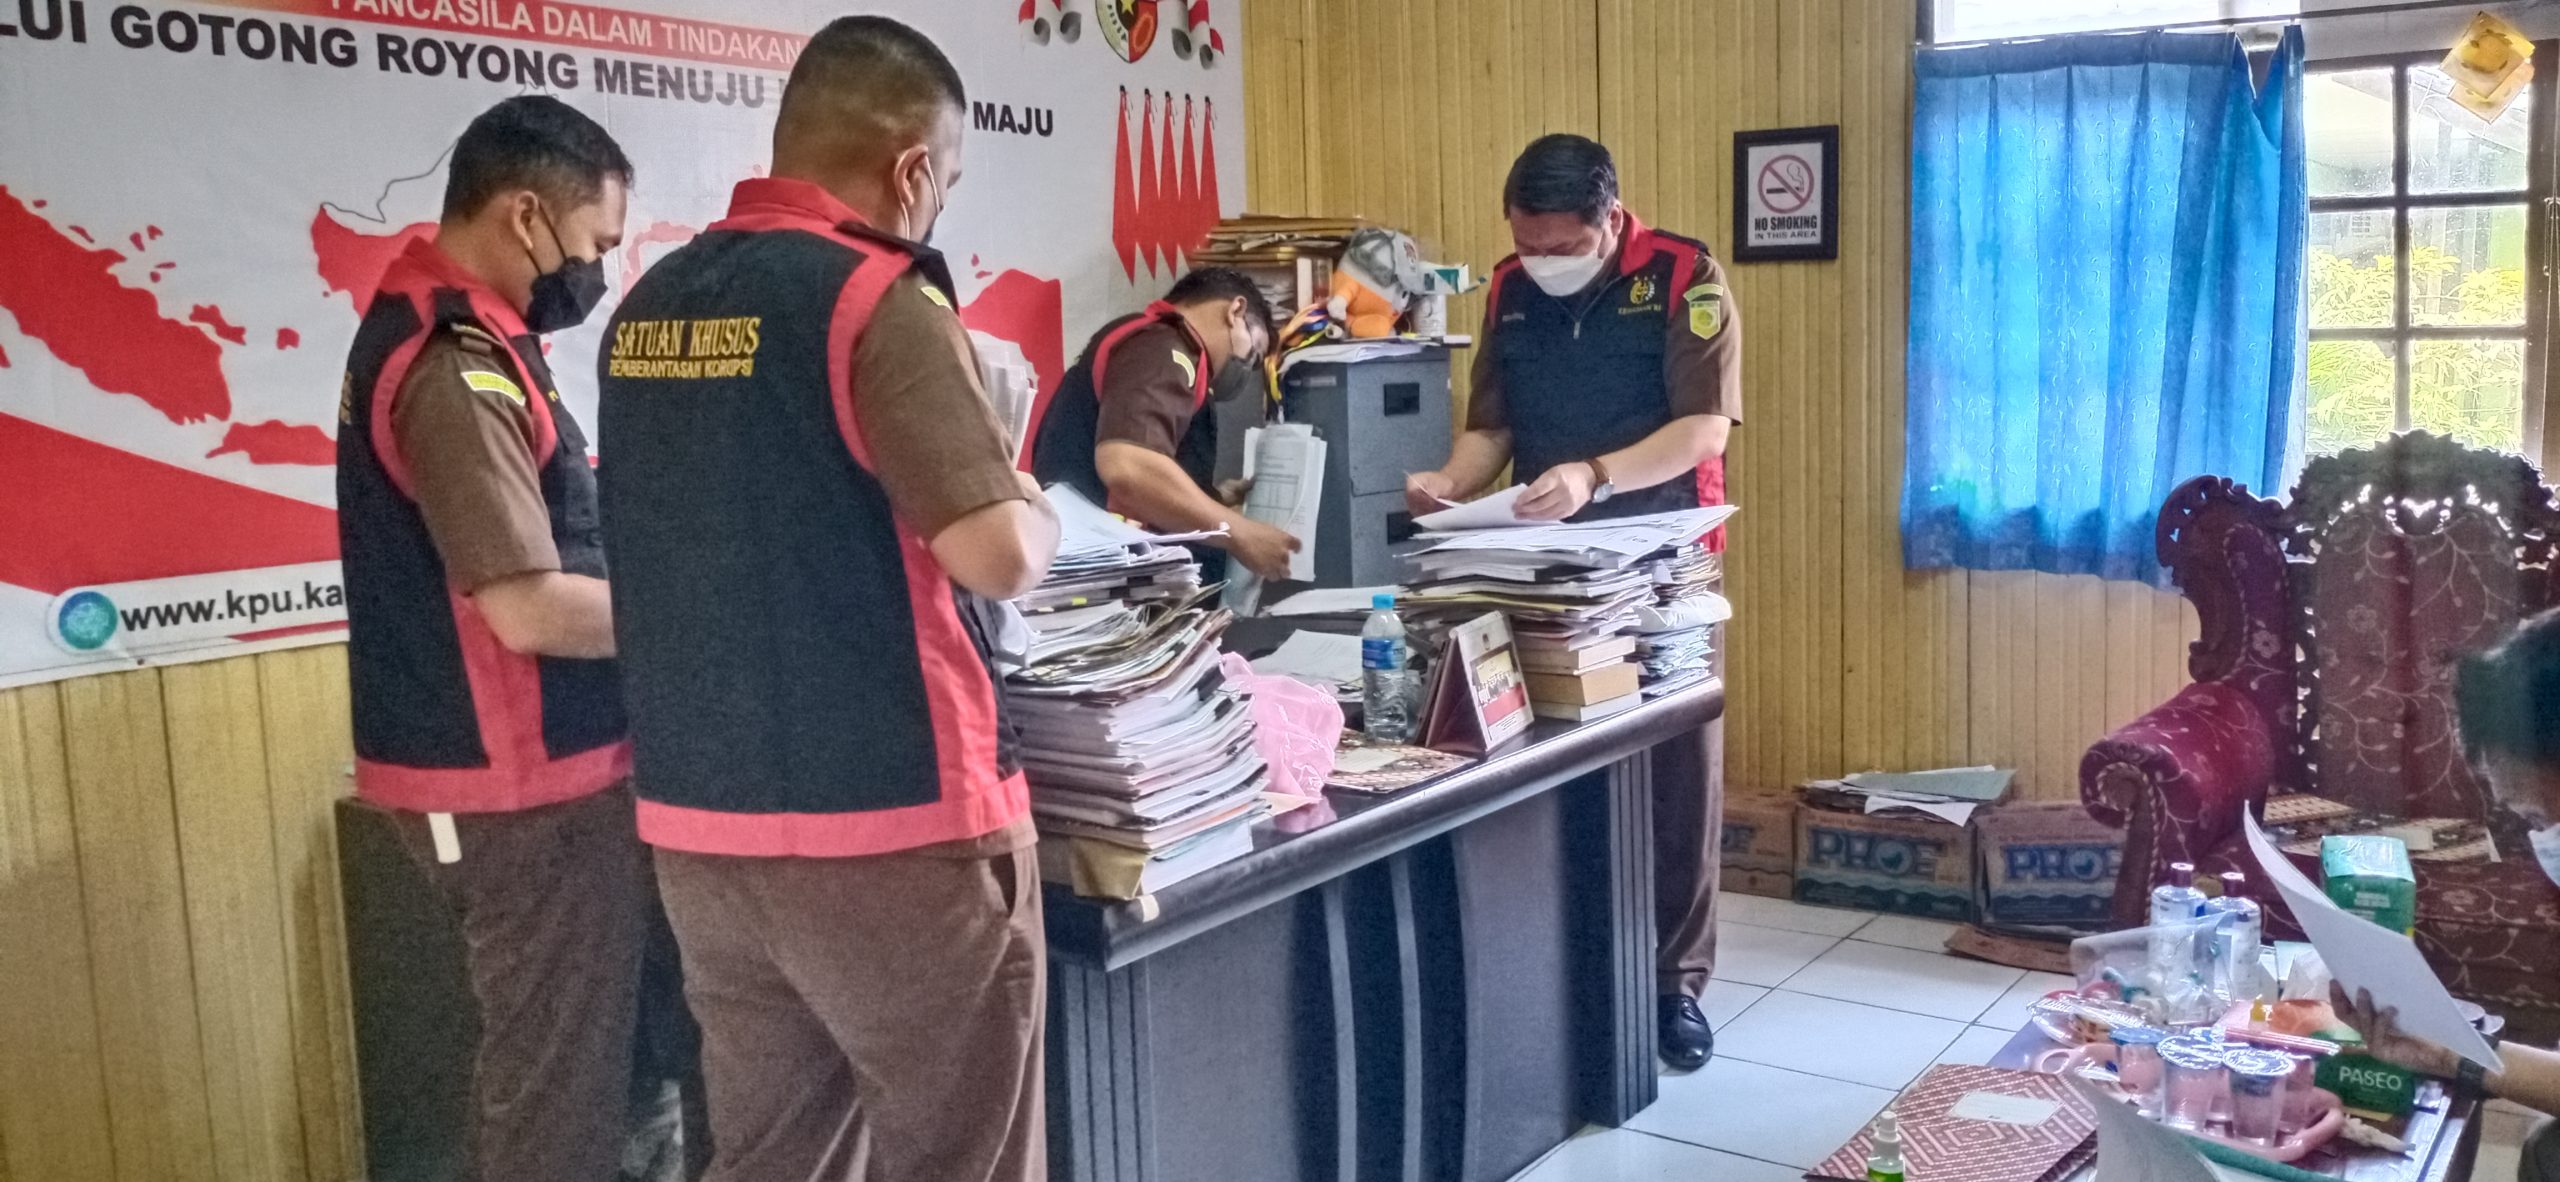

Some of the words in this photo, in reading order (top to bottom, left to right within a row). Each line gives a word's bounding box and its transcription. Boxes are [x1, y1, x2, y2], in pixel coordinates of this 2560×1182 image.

[542, 6, 652, 47] DALAM
[660, 21, 801, 65] TINDAKAN
[111, 5, 357, 68] GOTONG
[376, 33, 578, 90] ROYONG
[594, 57, 765, 108] MENUJU
[973, 101, 1053, 137] MAJU
[1754, 217, 1768, 231] NO
[1770, 215, 1818, 230] SMOKING
[1754, 232, 1764, 240] IN
[1767, 231, 1787, 239] THIS
[1790, 230, 1817, 238] AREA
[611, 321, 685, 357] SATUAN
[688, 316, 762, 357] KHUSUS
[609, 358, 701, 378] PEMBERANTASAN
[704, 357, 755, 378] KORUPSI
[120, 581, 344, 632] www.kpu.ka
[2339, 1066, 2402, 1091] PASEO
